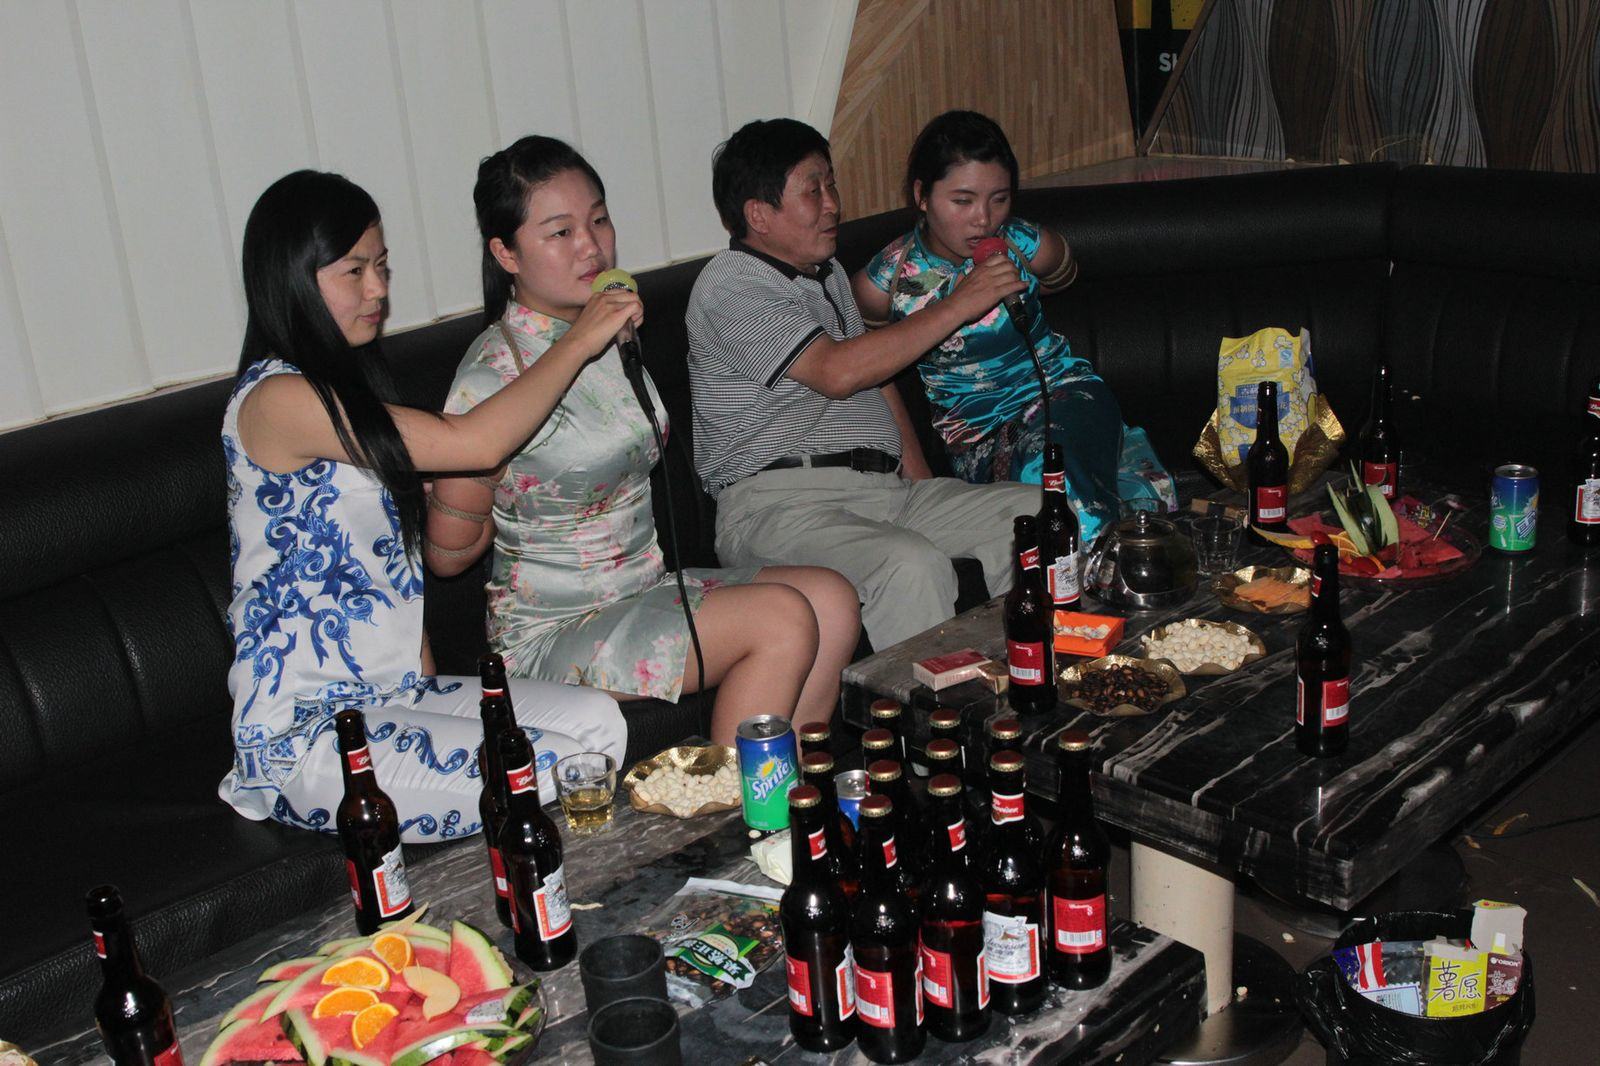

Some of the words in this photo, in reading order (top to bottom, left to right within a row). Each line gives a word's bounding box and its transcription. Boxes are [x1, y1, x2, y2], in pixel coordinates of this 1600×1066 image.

[752, 761, 789, 800] Sprite
[1430, 960, 1481, 1001] 薯愿
[1498, 959, 1518, 967] ORION
